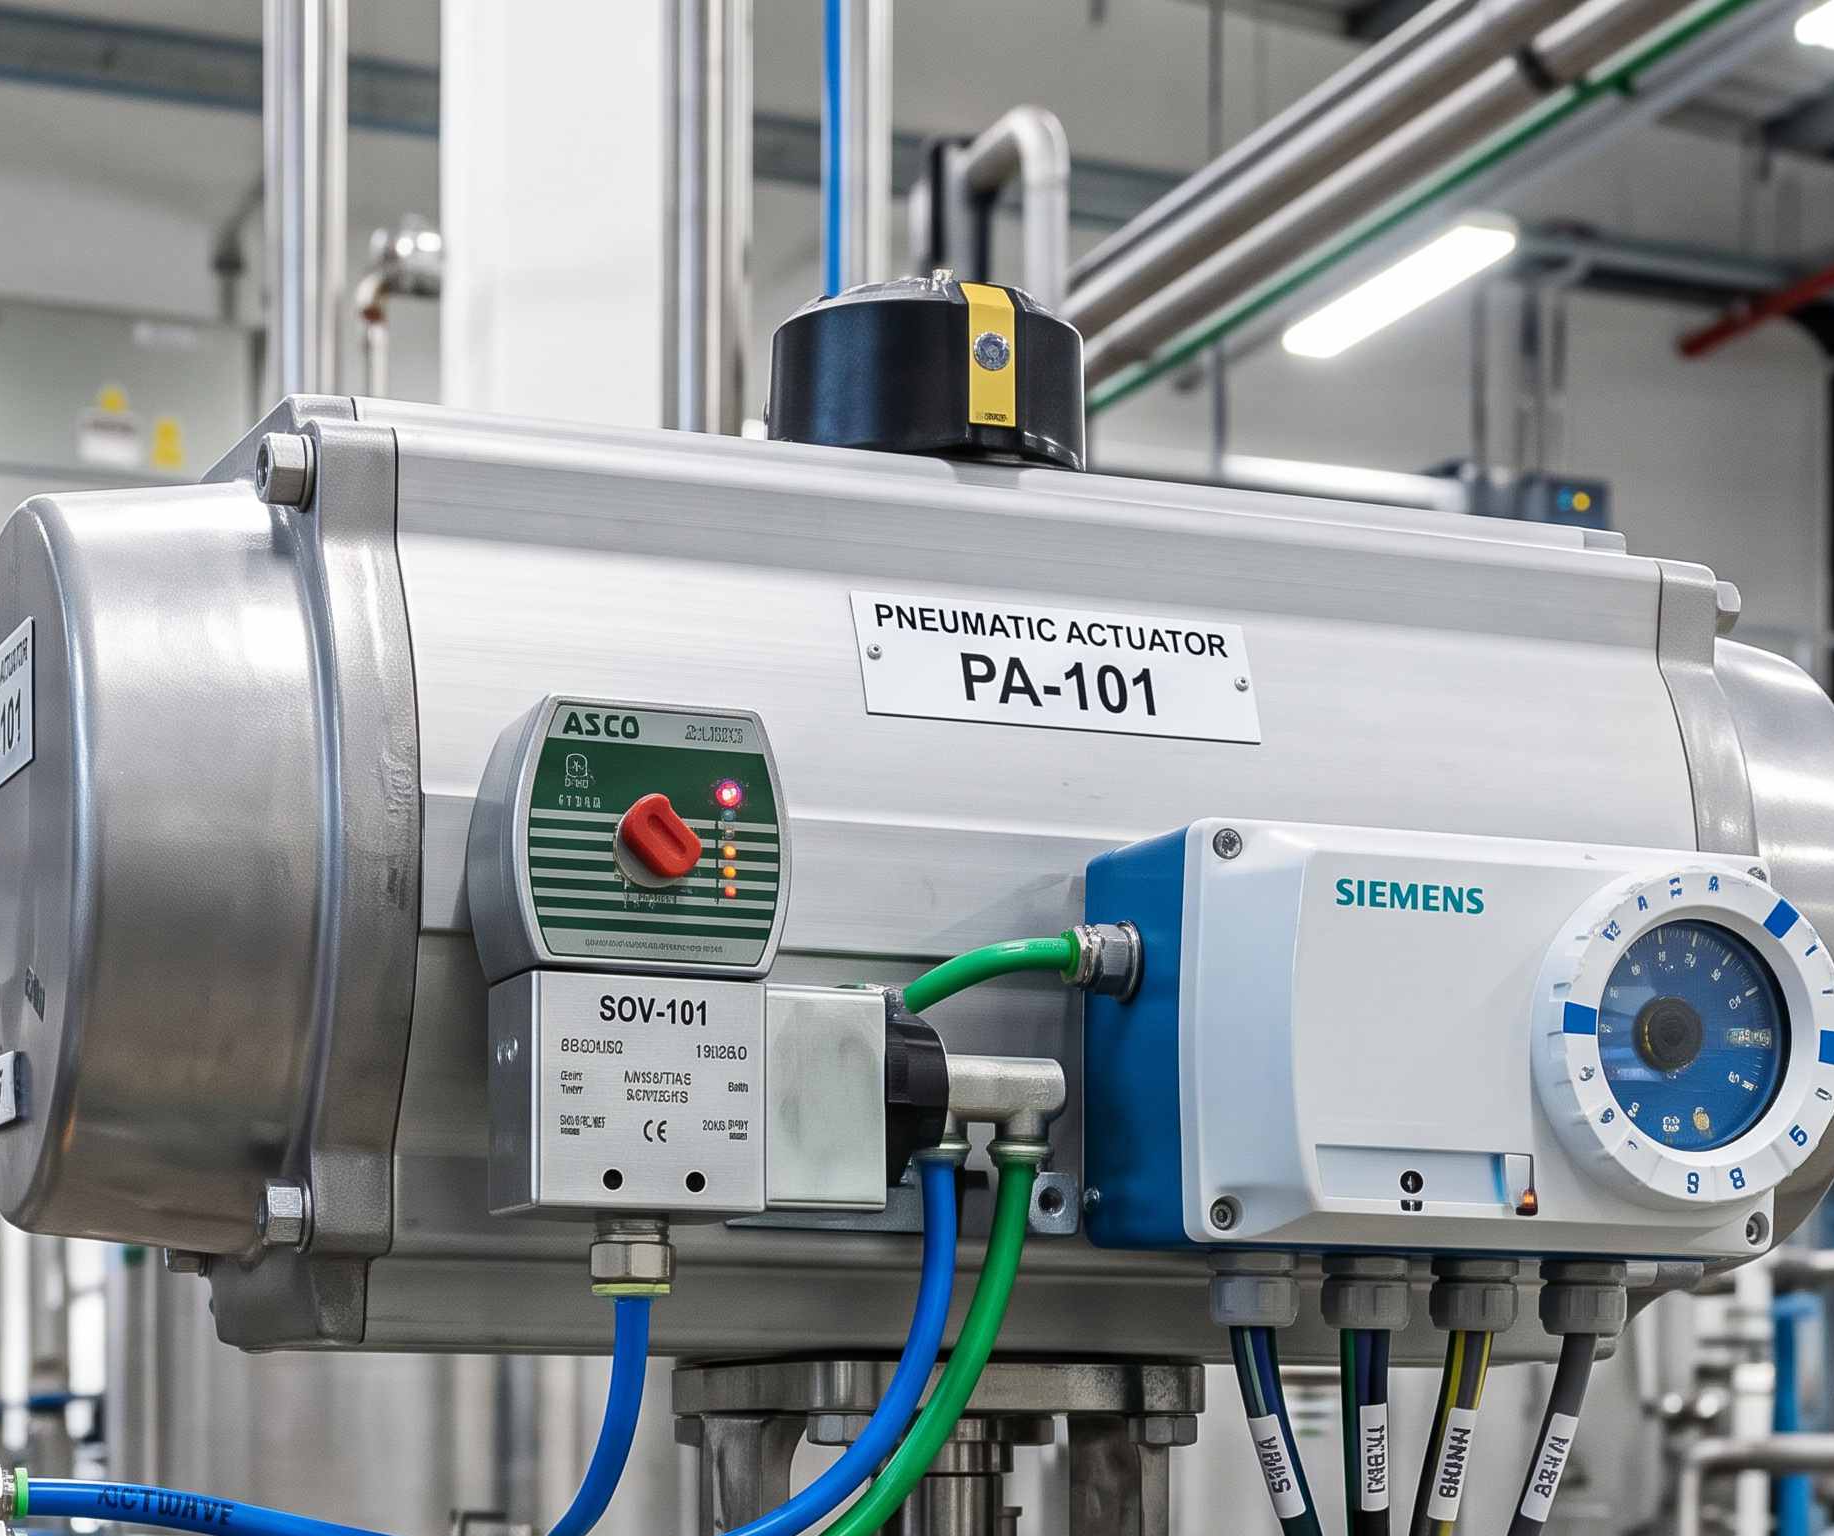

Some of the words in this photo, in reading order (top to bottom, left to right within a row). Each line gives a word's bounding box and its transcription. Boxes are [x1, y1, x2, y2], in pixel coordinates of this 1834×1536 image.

[875, 603, 1057, 642] PNEUMATIC
[1066, 621, 1229, 658] ACTUATOR
[960, 652, 1157, 716] PA-101
[562, 711, 640, 739] ASCO
[1335, 878, 1485, 915] SIEMENS
[599, 995, 707, 1026] SOV-101
